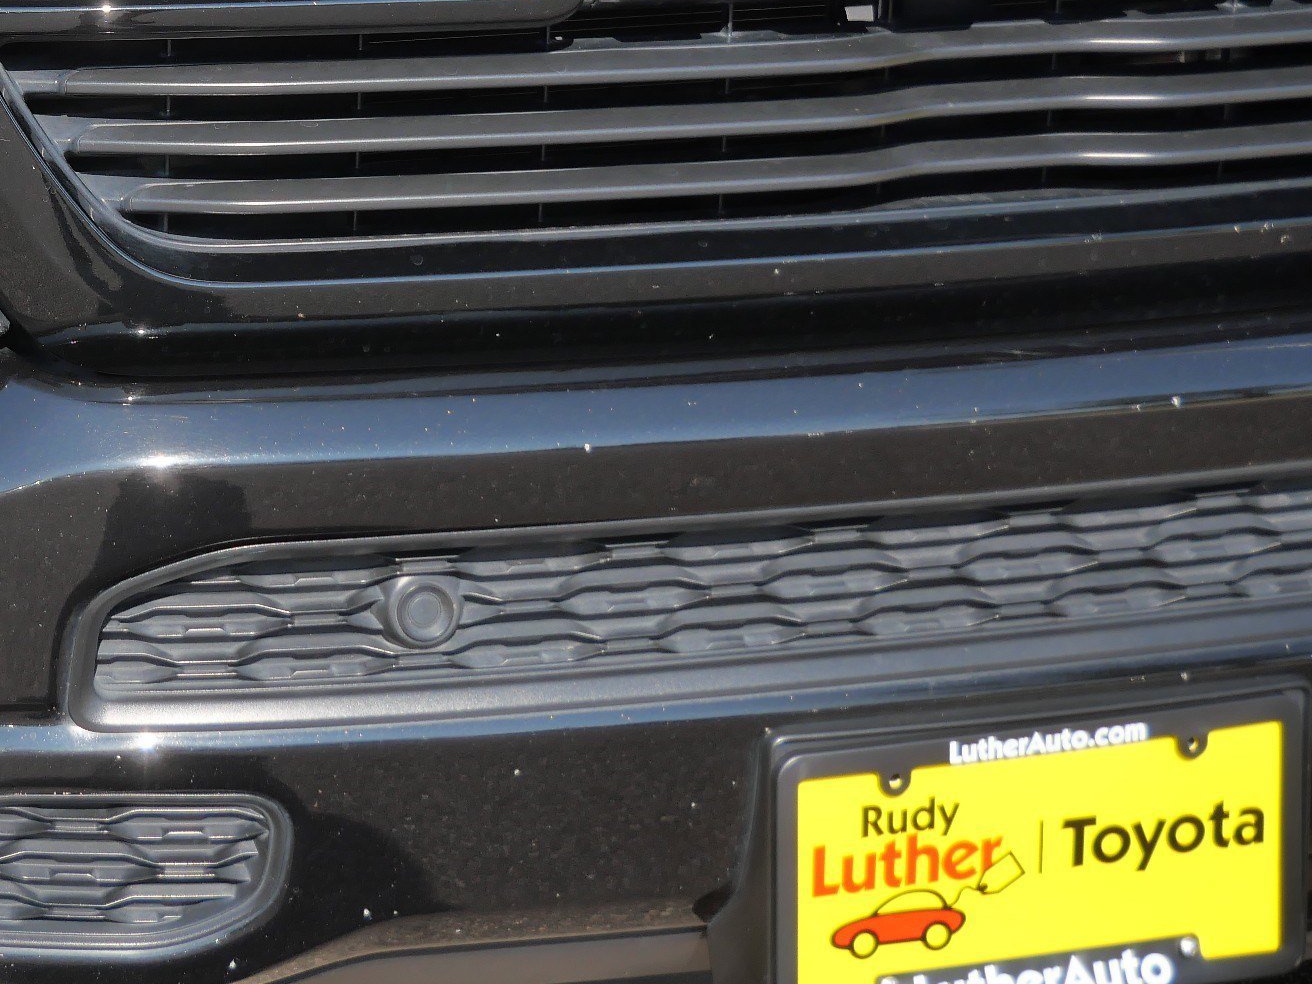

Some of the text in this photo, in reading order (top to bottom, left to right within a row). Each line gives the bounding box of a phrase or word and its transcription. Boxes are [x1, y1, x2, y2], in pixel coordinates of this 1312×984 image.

[948, 722, 1148, 765] LutherAuto.com
[861, 796, 960, 838] Rudy
[1062, 800, 1265, 871] Toyota
[811, 833, 1003, 898] Luther
[913, 948, 1174, 984] herAuto
